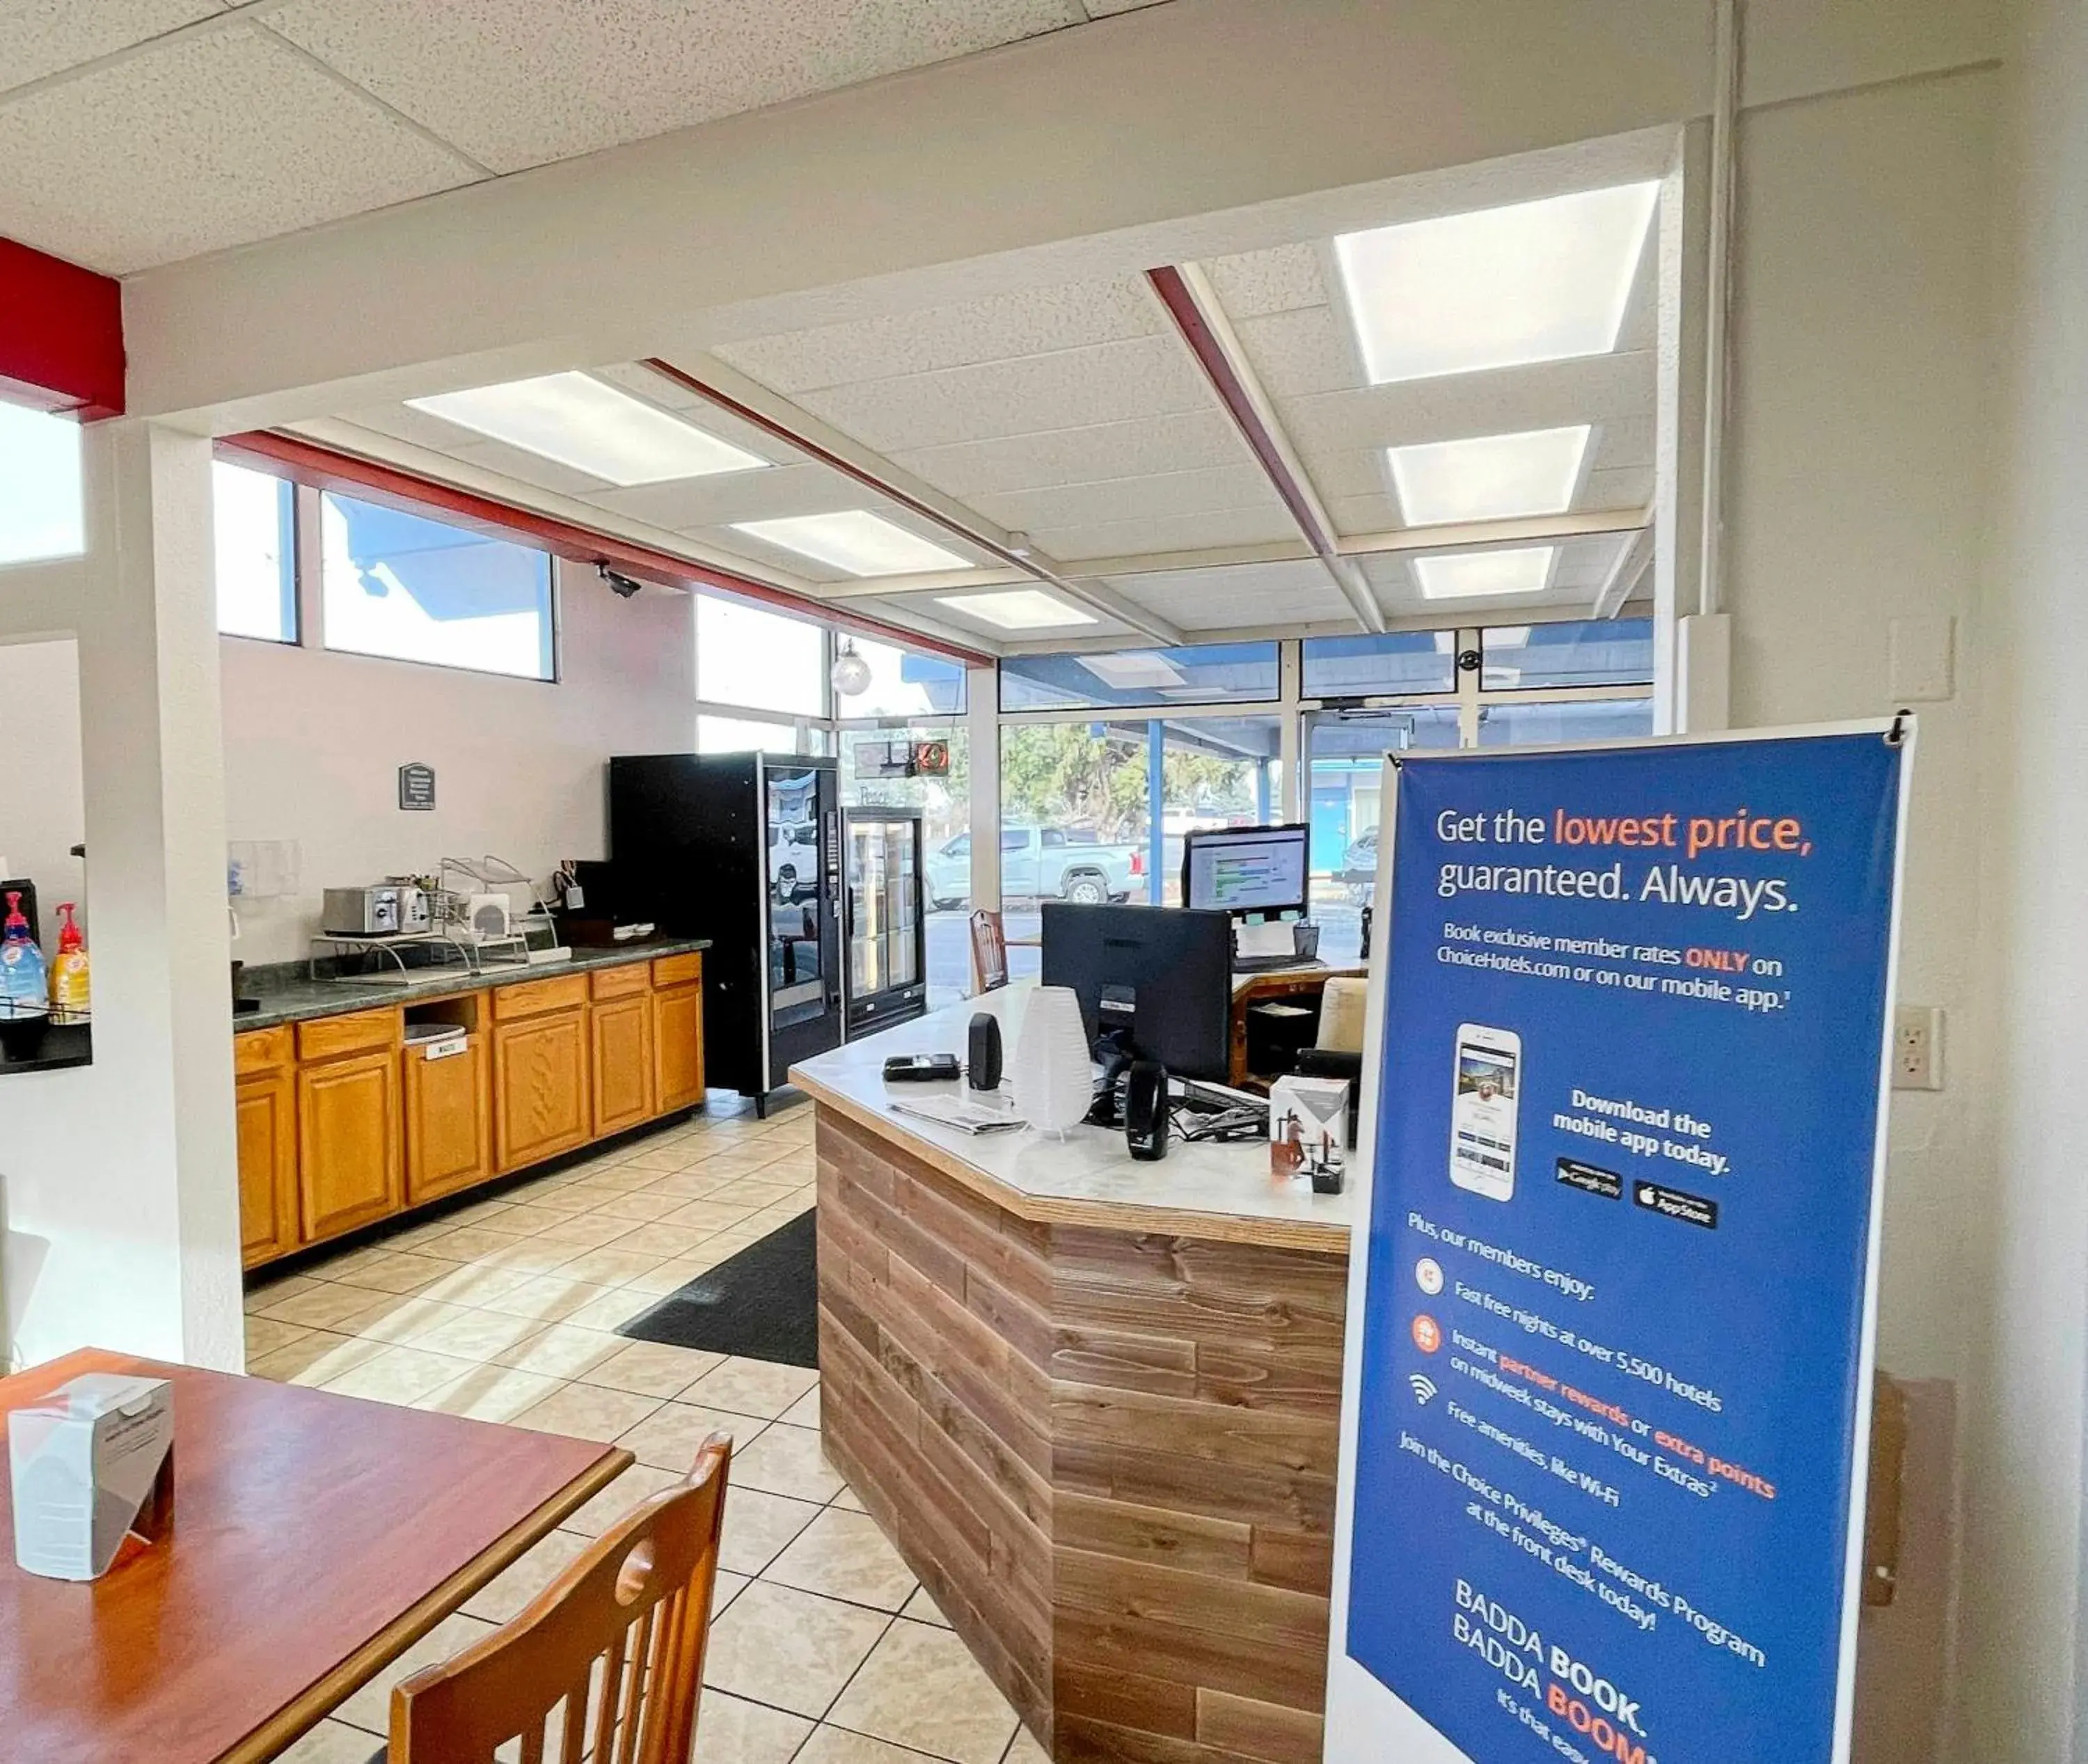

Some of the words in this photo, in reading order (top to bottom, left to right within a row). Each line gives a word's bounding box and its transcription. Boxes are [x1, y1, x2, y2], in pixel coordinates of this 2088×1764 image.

[1437, 810, 1487, 842] Get
[1493, 808, 1545, 844] the
[1555, 808, 1677, 846] lowest
[1688, 808, 1811, 858] price,
[1437, 863, 1629, 900] guaranteed.
[1639, 865, 1797, 920] Always.
[1437, 946, 1571, 979] ChoiceHotels.com
[1573, 967, 1595, 982] or
[1596, 970, 1620, 986] on
[1624, 974, 1658, 991] our
[1661, 977, 1732, 1002] mobile
[1444, 922, 1481, 942] Book
[1483, 929, 1551, 950] exclusive
[1554, 938, 1629, 959] member
[1633, 946, 1682, 965] rates
[1685, 948, 1750, 972] ONLY
[1753, 959, 1782, 977] on
[1553, 1113, 1618, 1142] mobile
[1620, 1131, 1660, 1157] app
[1662, 1140, 1730, 1174] today.
[1572, 1089, 1670, 1128] Download
[1673, 1114, 1711, 1138] the
[1408, 1212, 1439, 1240] Plus,
[1440, 1229, 1466, 1247] our
[1467, 1240, 1542, 1279] members
[1455, 1281, 1482, 1305] Fast
[1483, 1293, 1512, 1318] free
[1512, 1310, 1558, 1339] nights
[1558, 1330, 1576, 1347] at
[1577, 1339, 1615, 1362] over
[1616, 1351, 1663, 1385] 5,500
[1666, 1372, 1722, 1412] hotels
[1450, 1357, 1469, 1374] on
[1470, 1367, 1532, 1407] midweek
[1533, 1399, 1572, 1426] stays
[1574, 1418, 1608, 1446] with
[1611, 1433, 1652, 1465] Your
[1452, 1329, 1498, 1364] Instant
[1498, 1354, 1558, 1391] partner
[1560, 1384, 1629, 1427] rewards
[1631, 1419, 1652, 1436] or
[1654, 1431, 1705, 1465] extra
[1707, 1457, 1775, 1499] points
[1448, 1401, 1476, 1428] Free
[1478, 1421, 1548, 1470] amenities,
[1551, 1456, 1578, 1483] like
[1579, 1472, 1619, 1507] Wi-Fi
[1399, 1431, 1426, 1458] Join
[1427, 1449, 1451, 1473] the
[1452, 1463, 1501, 1504] Choice
[1590, 1546, 1670, 1607] Rewards
[1674, 1596, 1764, 1667] Program
[1466, 1502, 1482, 1521] at
[1484, 1511, 1510, 1537] the
[1512, 1527, 1552, 1566] front
[1554, 1556, 1596, 1592] desk
[1599, 1582, 1656, 1630] today!
[1454, 1614, 1542, 1699] BADDA
[1455, 1579, 1544, 1663] BADDA
[1550, 1646, 1647, 1738] BOOK.
[1552, 1735, 1590, 1764] eas
